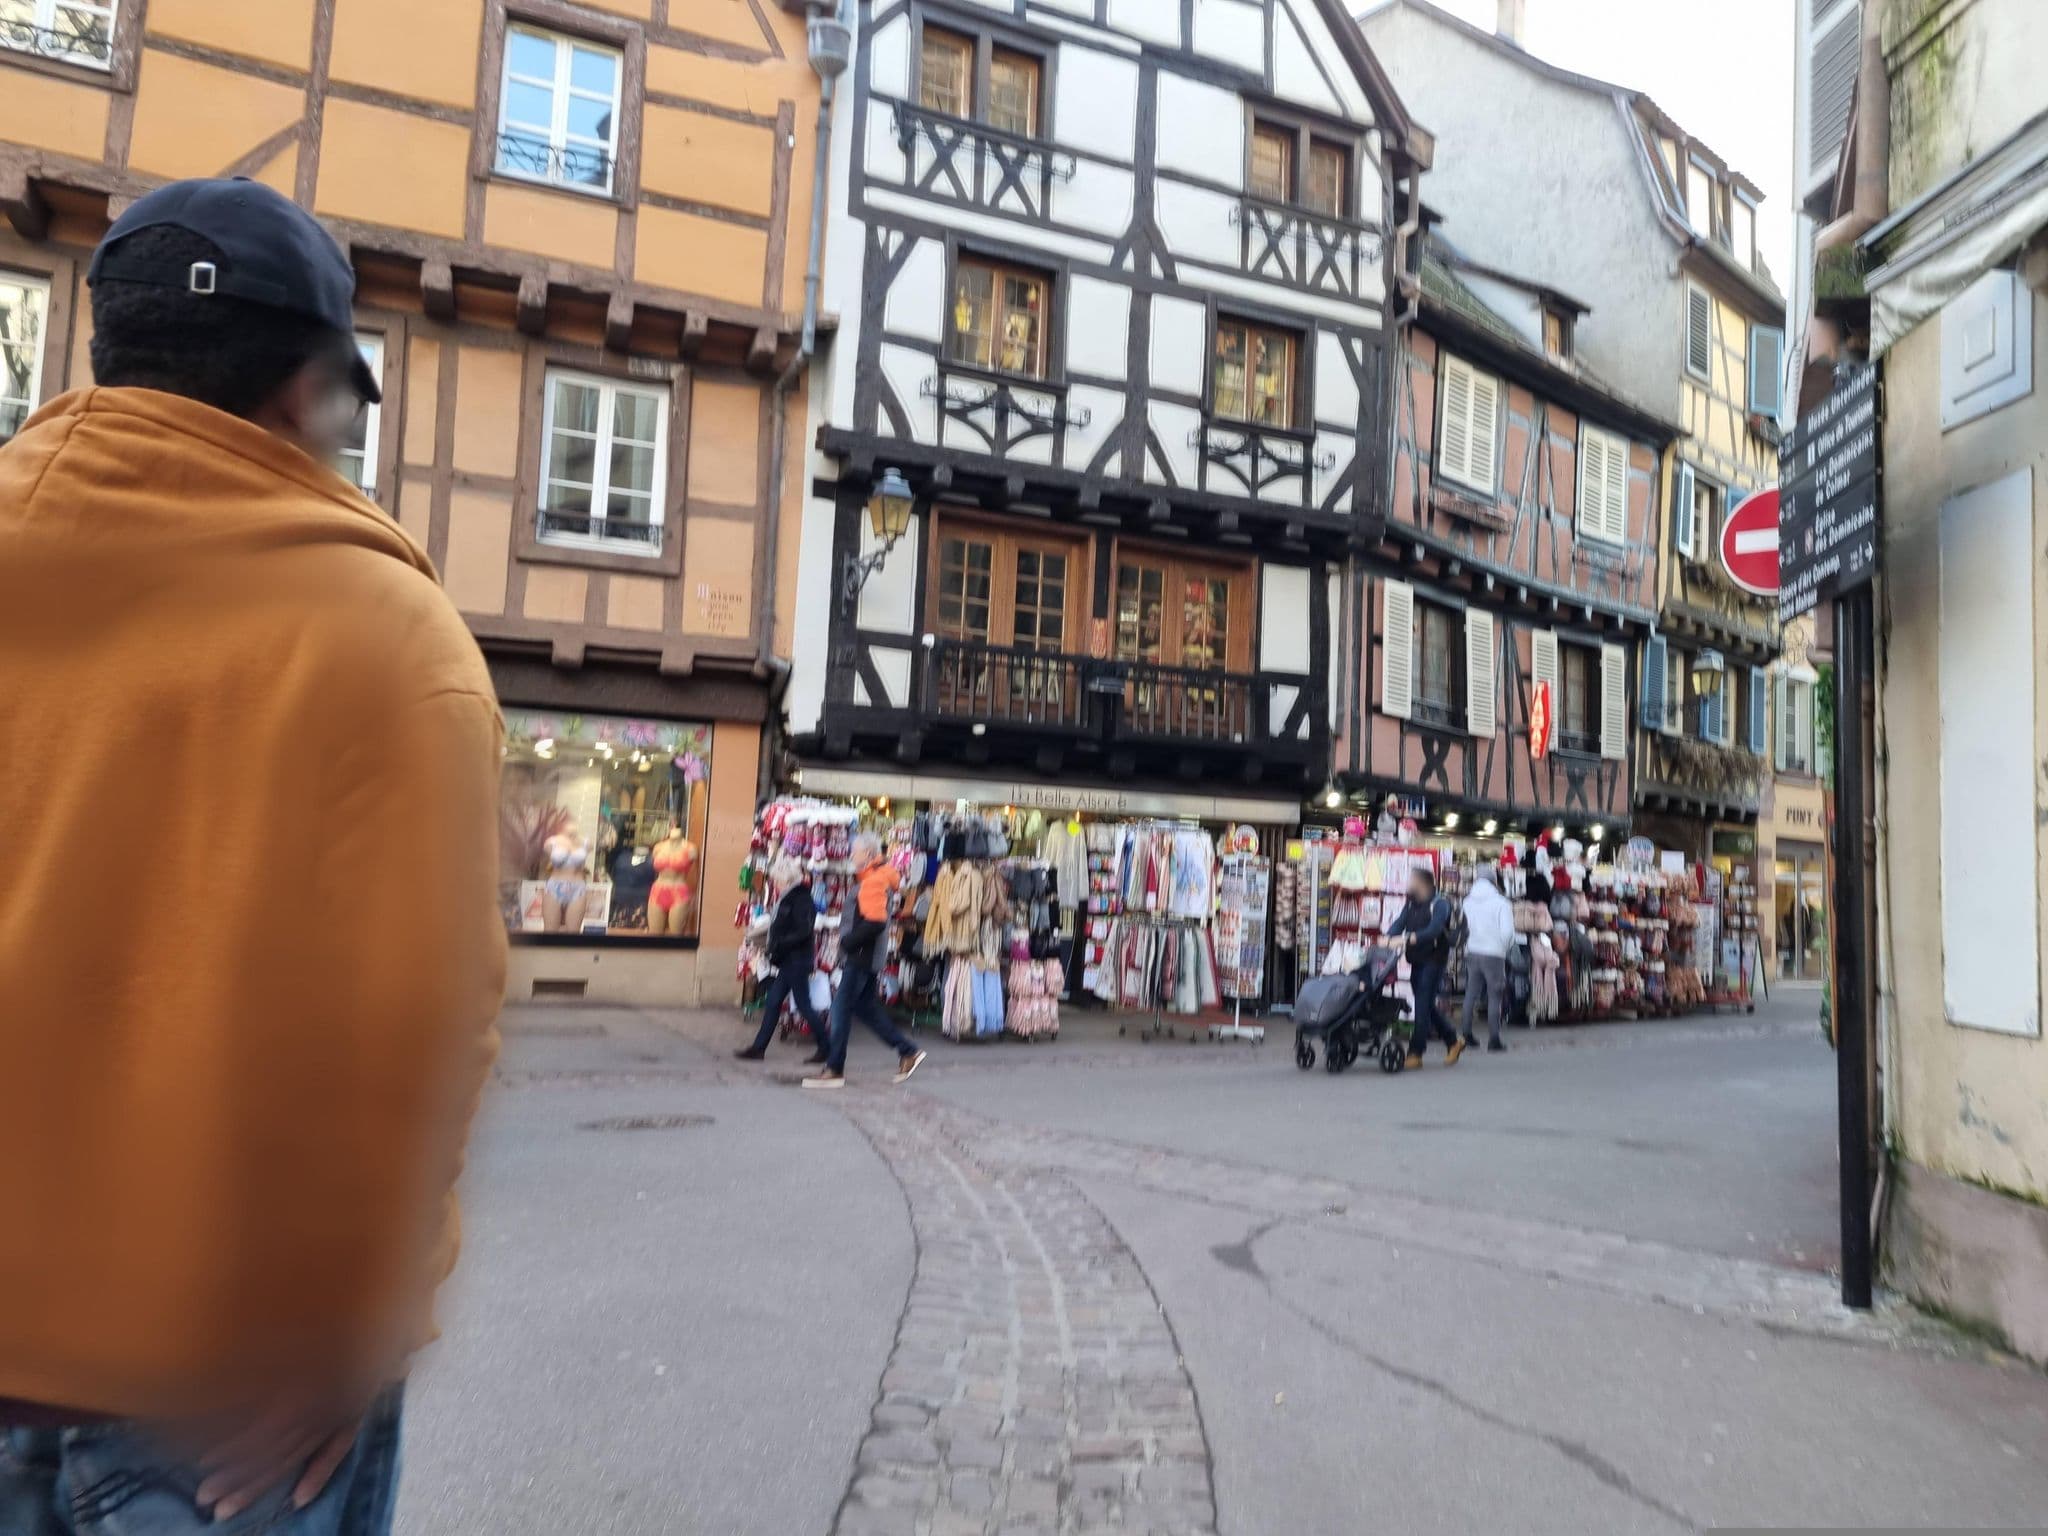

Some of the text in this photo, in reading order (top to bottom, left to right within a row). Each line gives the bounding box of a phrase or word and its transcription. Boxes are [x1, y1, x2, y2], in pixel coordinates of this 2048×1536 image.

[1808, 364, 1875, 437] Musée Unterlinden
[1816, 464, 1827, 488] Les
[1829, 429, 1874, 477] Dominicains
[1818, 430, 1835, 457] Office
[1836, 422, 1844, 444] de
[1816, 469, 1850, 508] de Colmar
[1816, 533, 1827, 555] des
[1829, 503, 1874, 545] Dominicains
[1531, 682, 1545, 759] TABAC
[1035, 786, 1071, 808] Belle
[1076, 790, 1127, 811] Alsace
